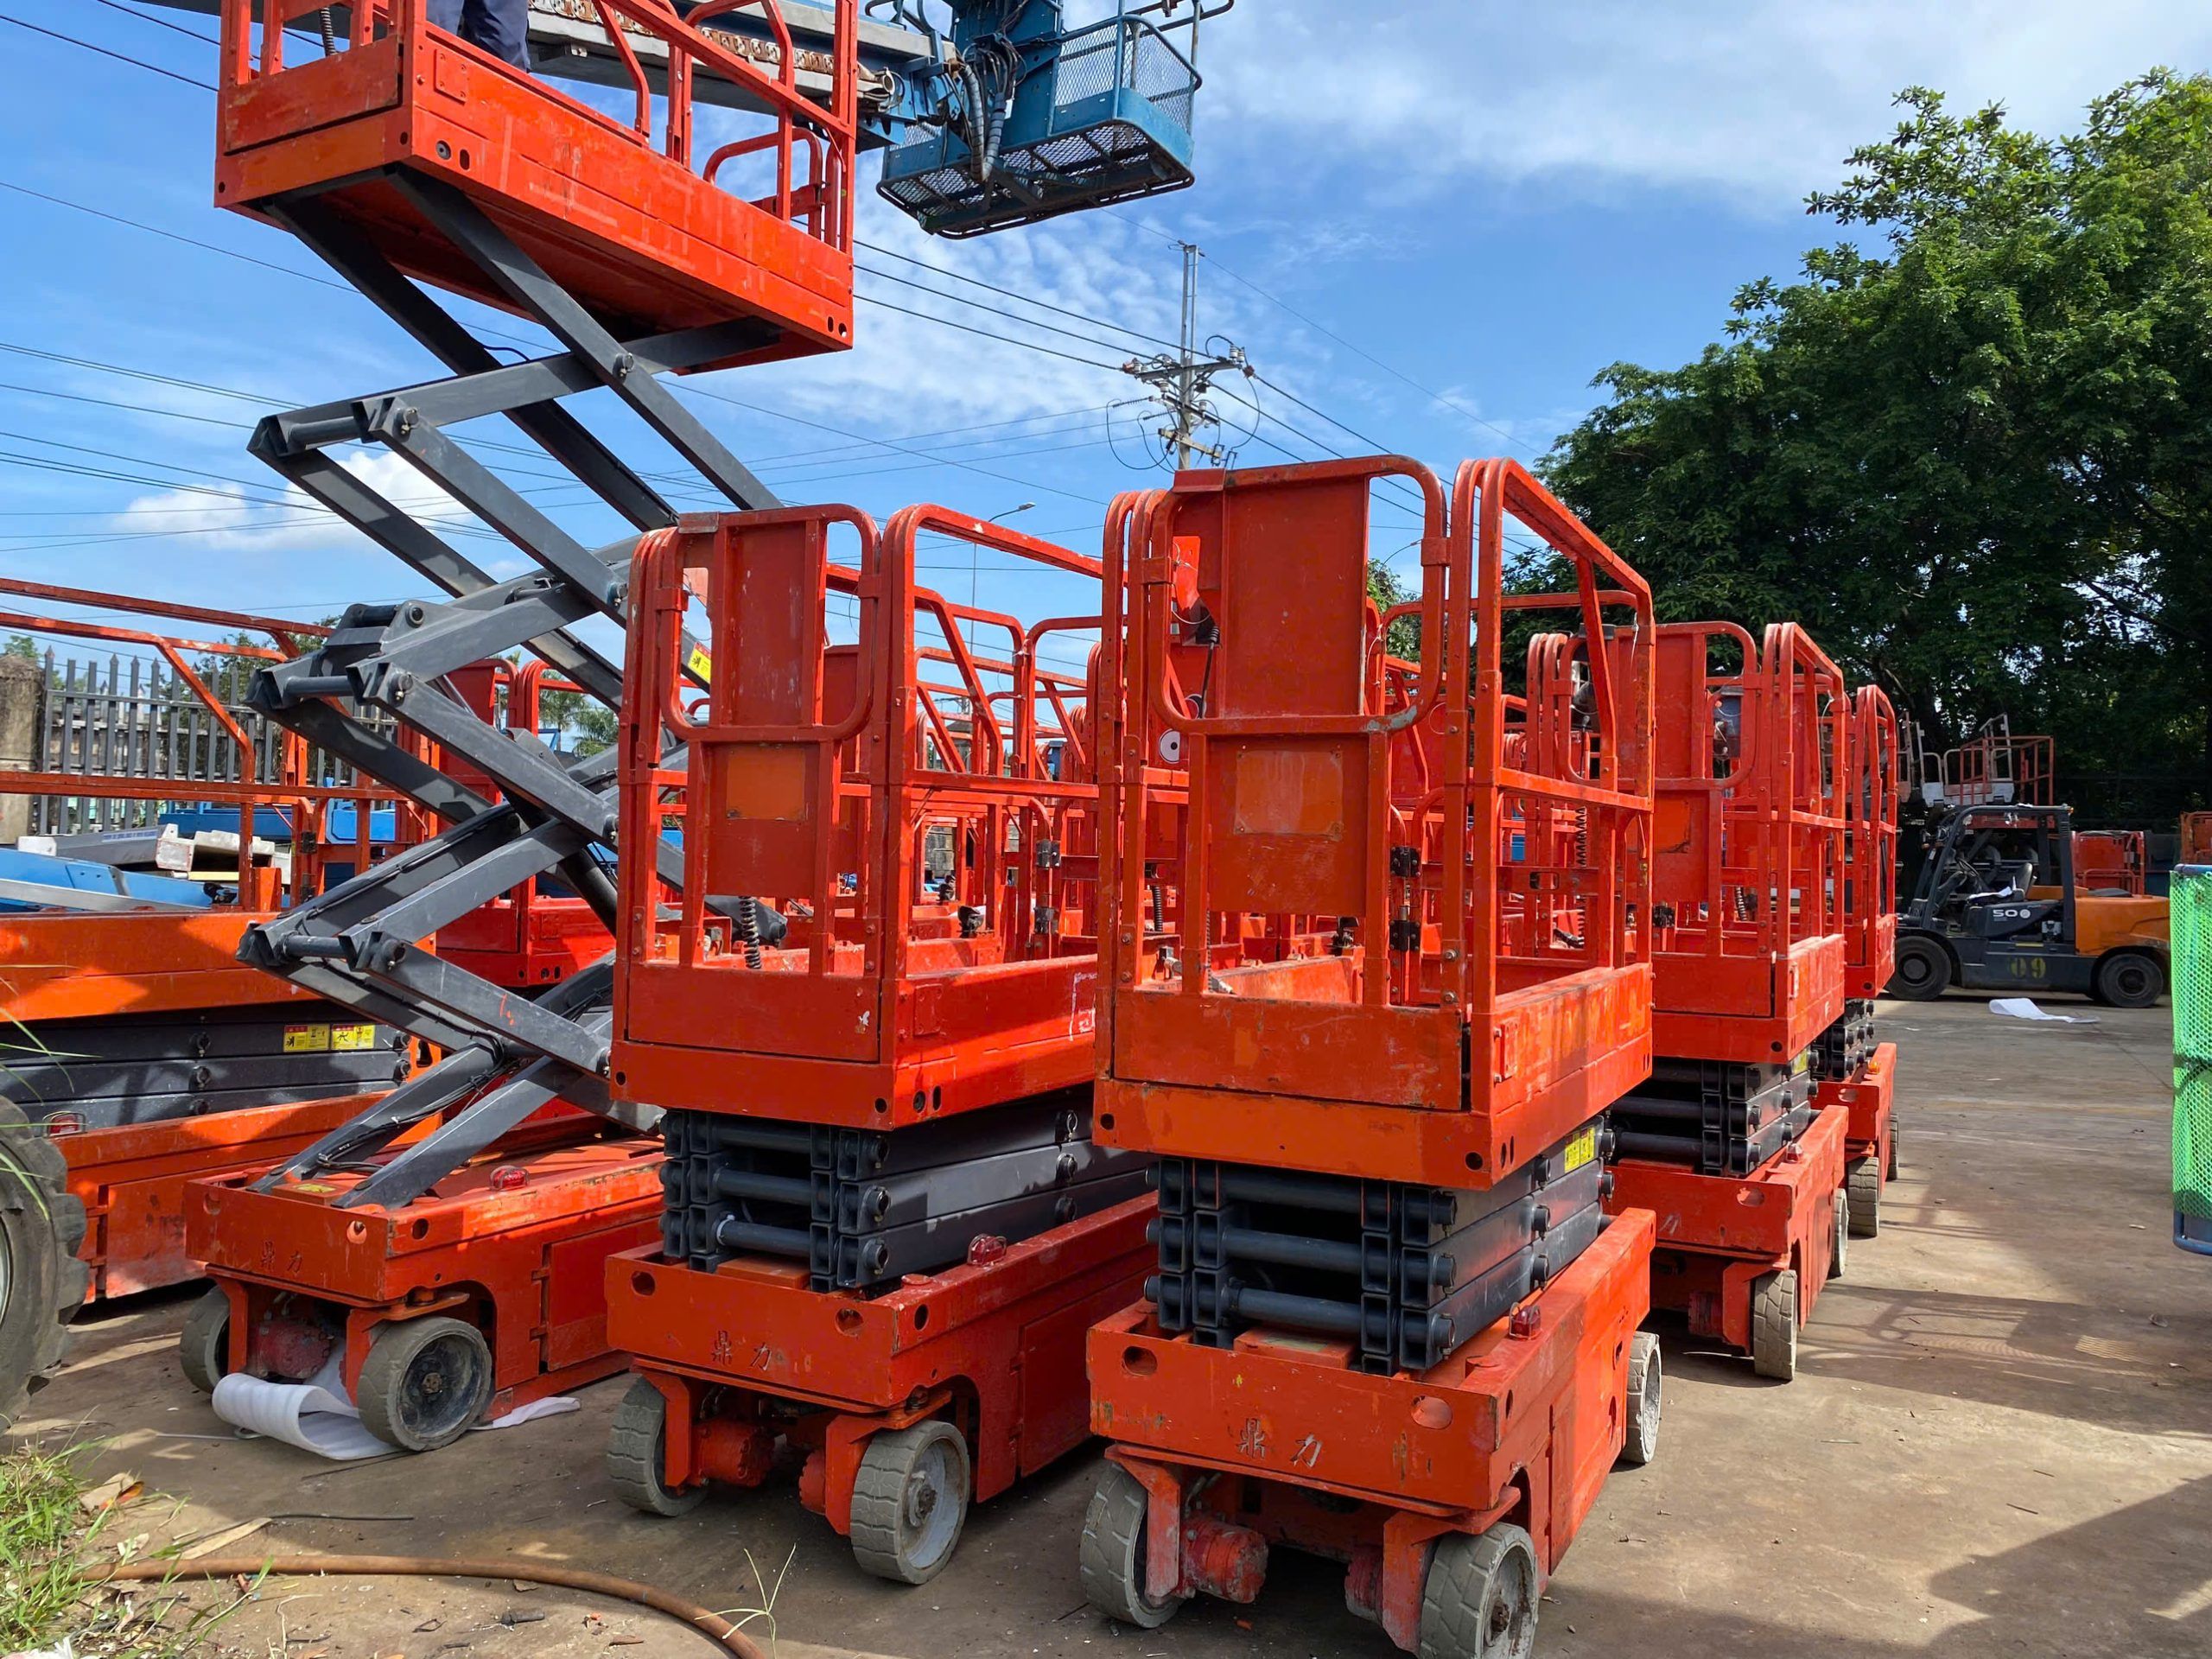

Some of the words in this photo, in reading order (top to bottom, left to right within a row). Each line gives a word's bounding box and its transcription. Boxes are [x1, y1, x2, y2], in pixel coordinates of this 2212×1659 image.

[1993, 909, 2018, 918] 50
[710, 1330, 772, 1372] 鼎力
[1236, 1417, 1323, 1467] 鼎力
